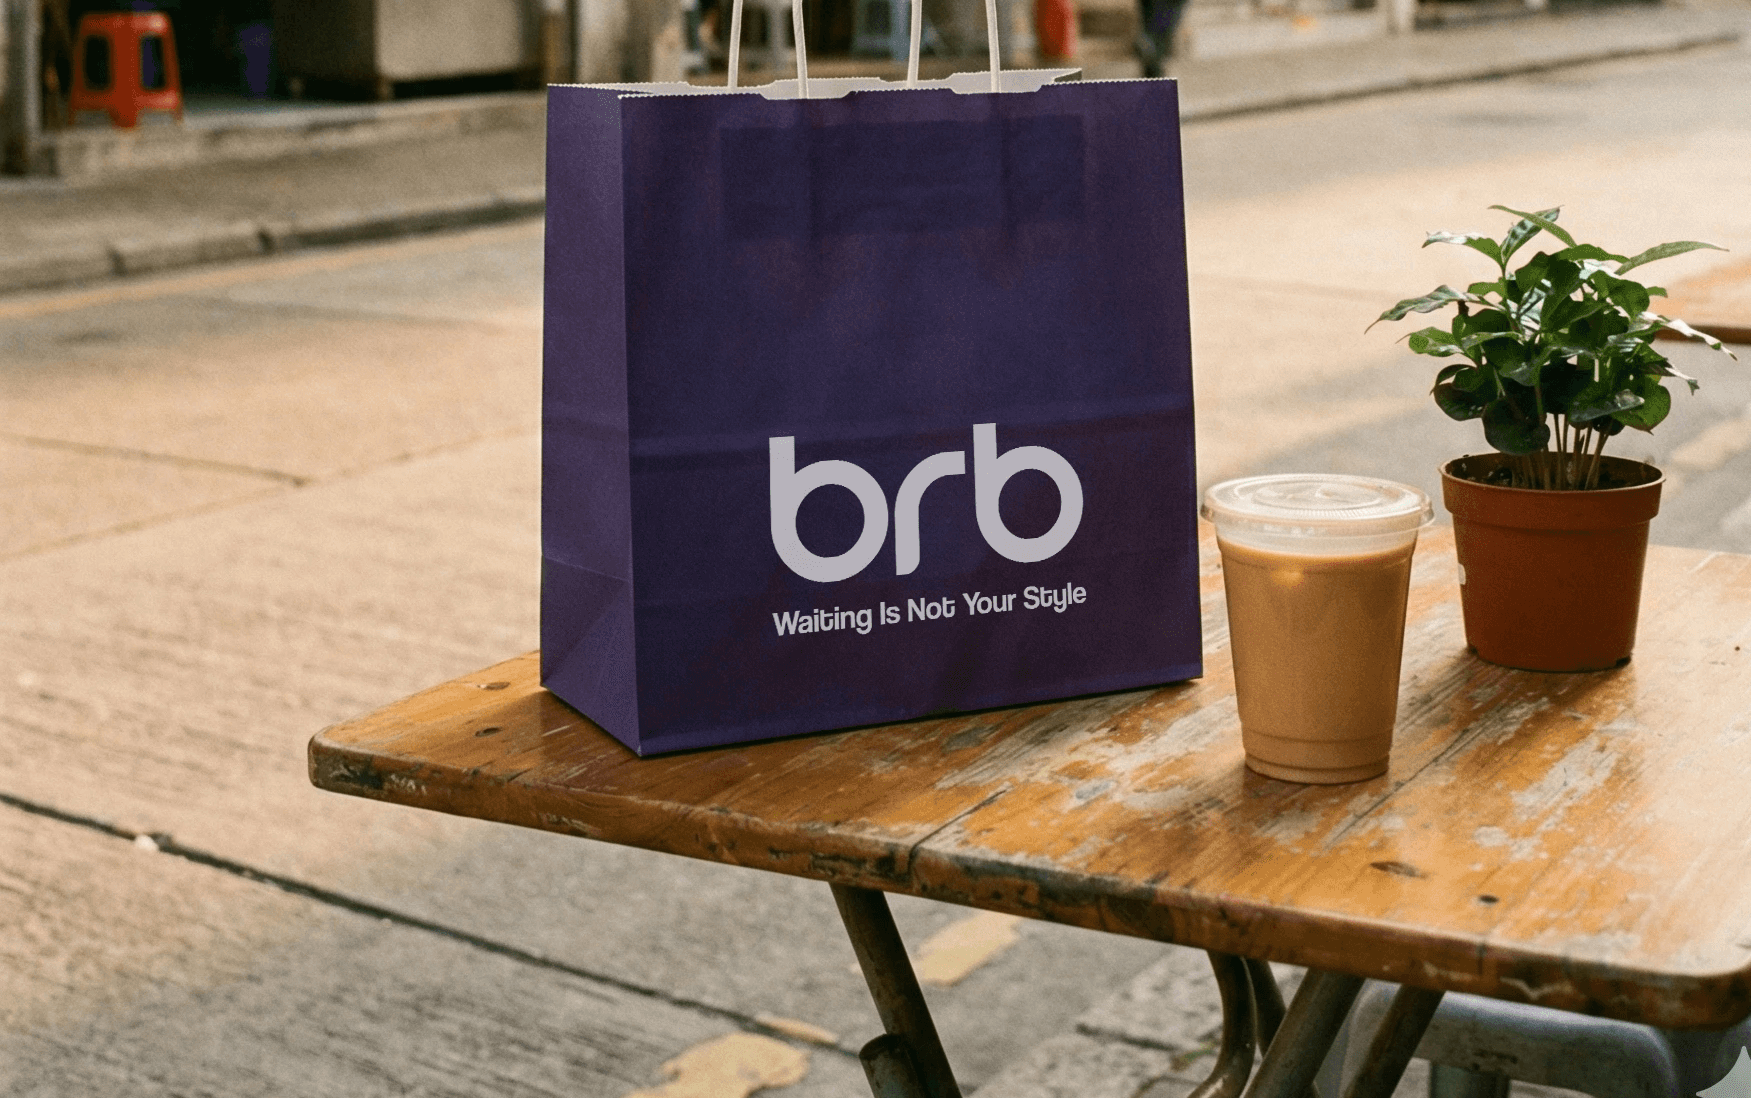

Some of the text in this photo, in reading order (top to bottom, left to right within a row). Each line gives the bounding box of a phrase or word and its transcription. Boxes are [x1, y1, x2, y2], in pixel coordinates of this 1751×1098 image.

[769, 423, 1084, 583] brb
[773, 582, 1087, 637] Waiting Is Not Your Style
